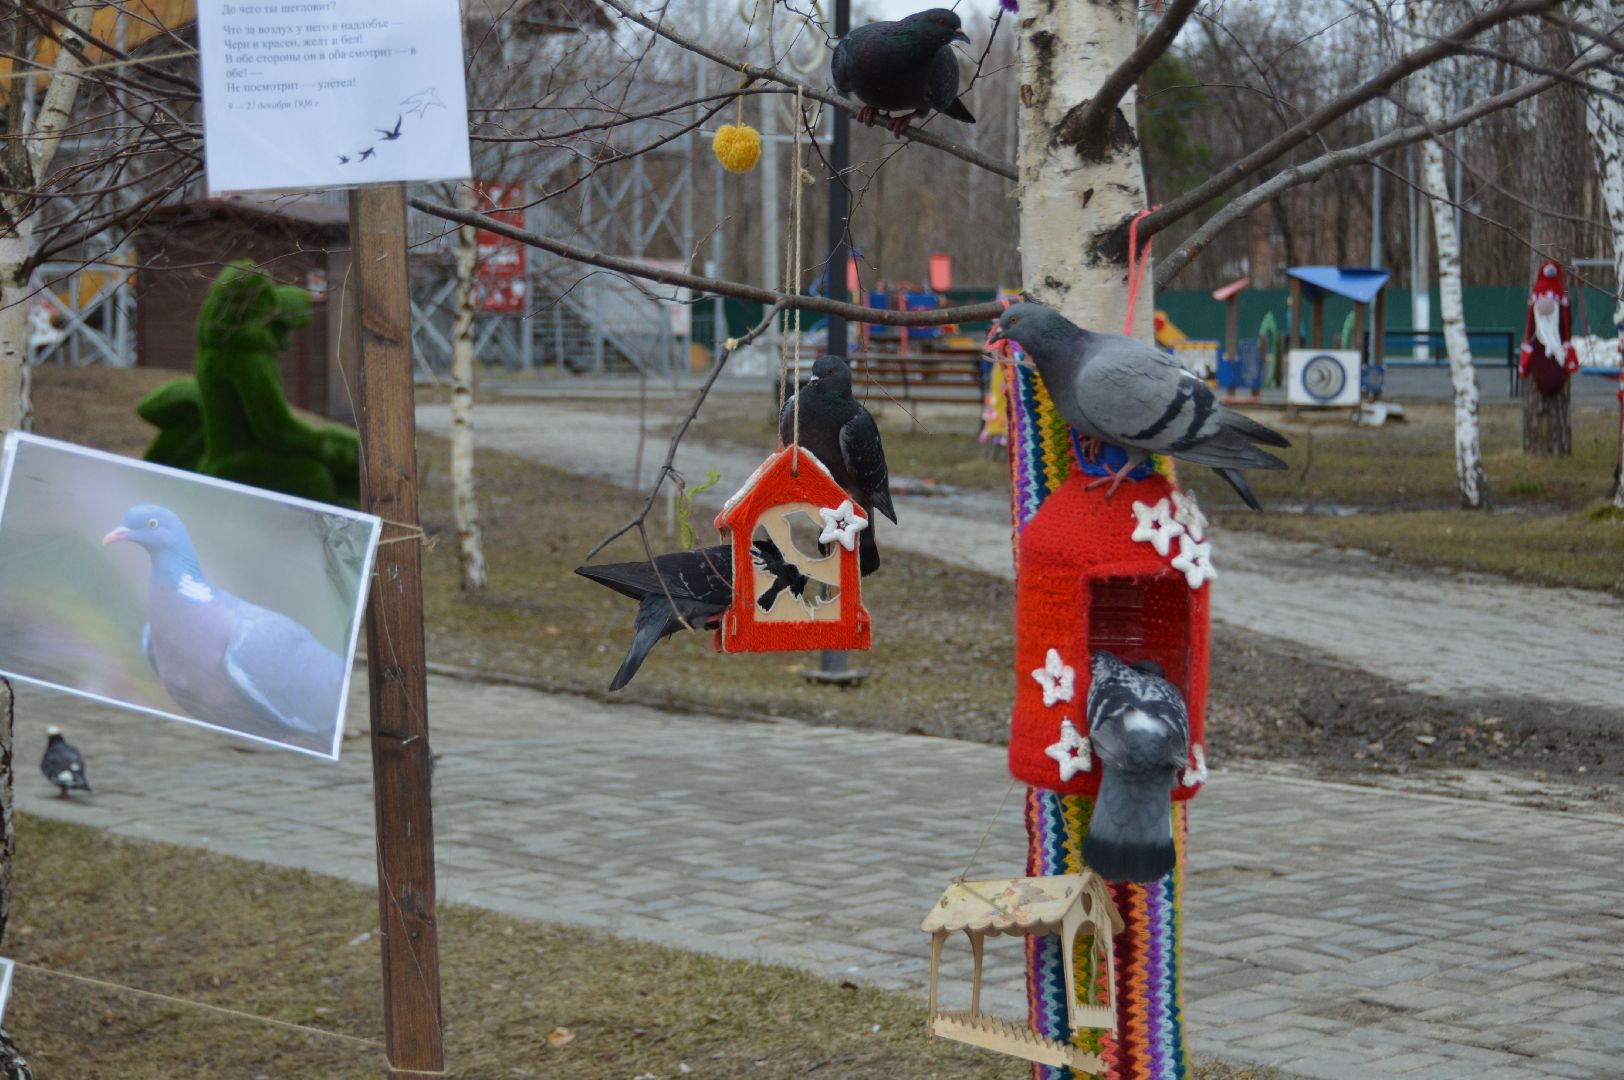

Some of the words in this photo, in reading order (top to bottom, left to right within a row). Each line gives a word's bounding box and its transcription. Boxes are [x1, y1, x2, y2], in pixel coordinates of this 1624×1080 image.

[222, 4, 236, 15] До
[239, 6, 262, 14] чего
[264, 5, 278, 14] ты
[223, 24, 242, 34] Что
[245, 26, 256, 34] за
[258, 25, 294, 36] воздух
[306, 24, 329, 32] него
[341, 33, 362, 45] бел!
[236, 52, 254, 64] обе
[256, 54, 300, 65] стороны
[303, 52, 317, 62] он
[328, 49, 346, 60] оба
[348, 48, 392, 60] смотрит
[226, 68, 248, 78] обе!
[226, 82, 241, 93] Не
[244, 82, 300, 93] посмотрит
[317, 76, 356, 92] улетел!
